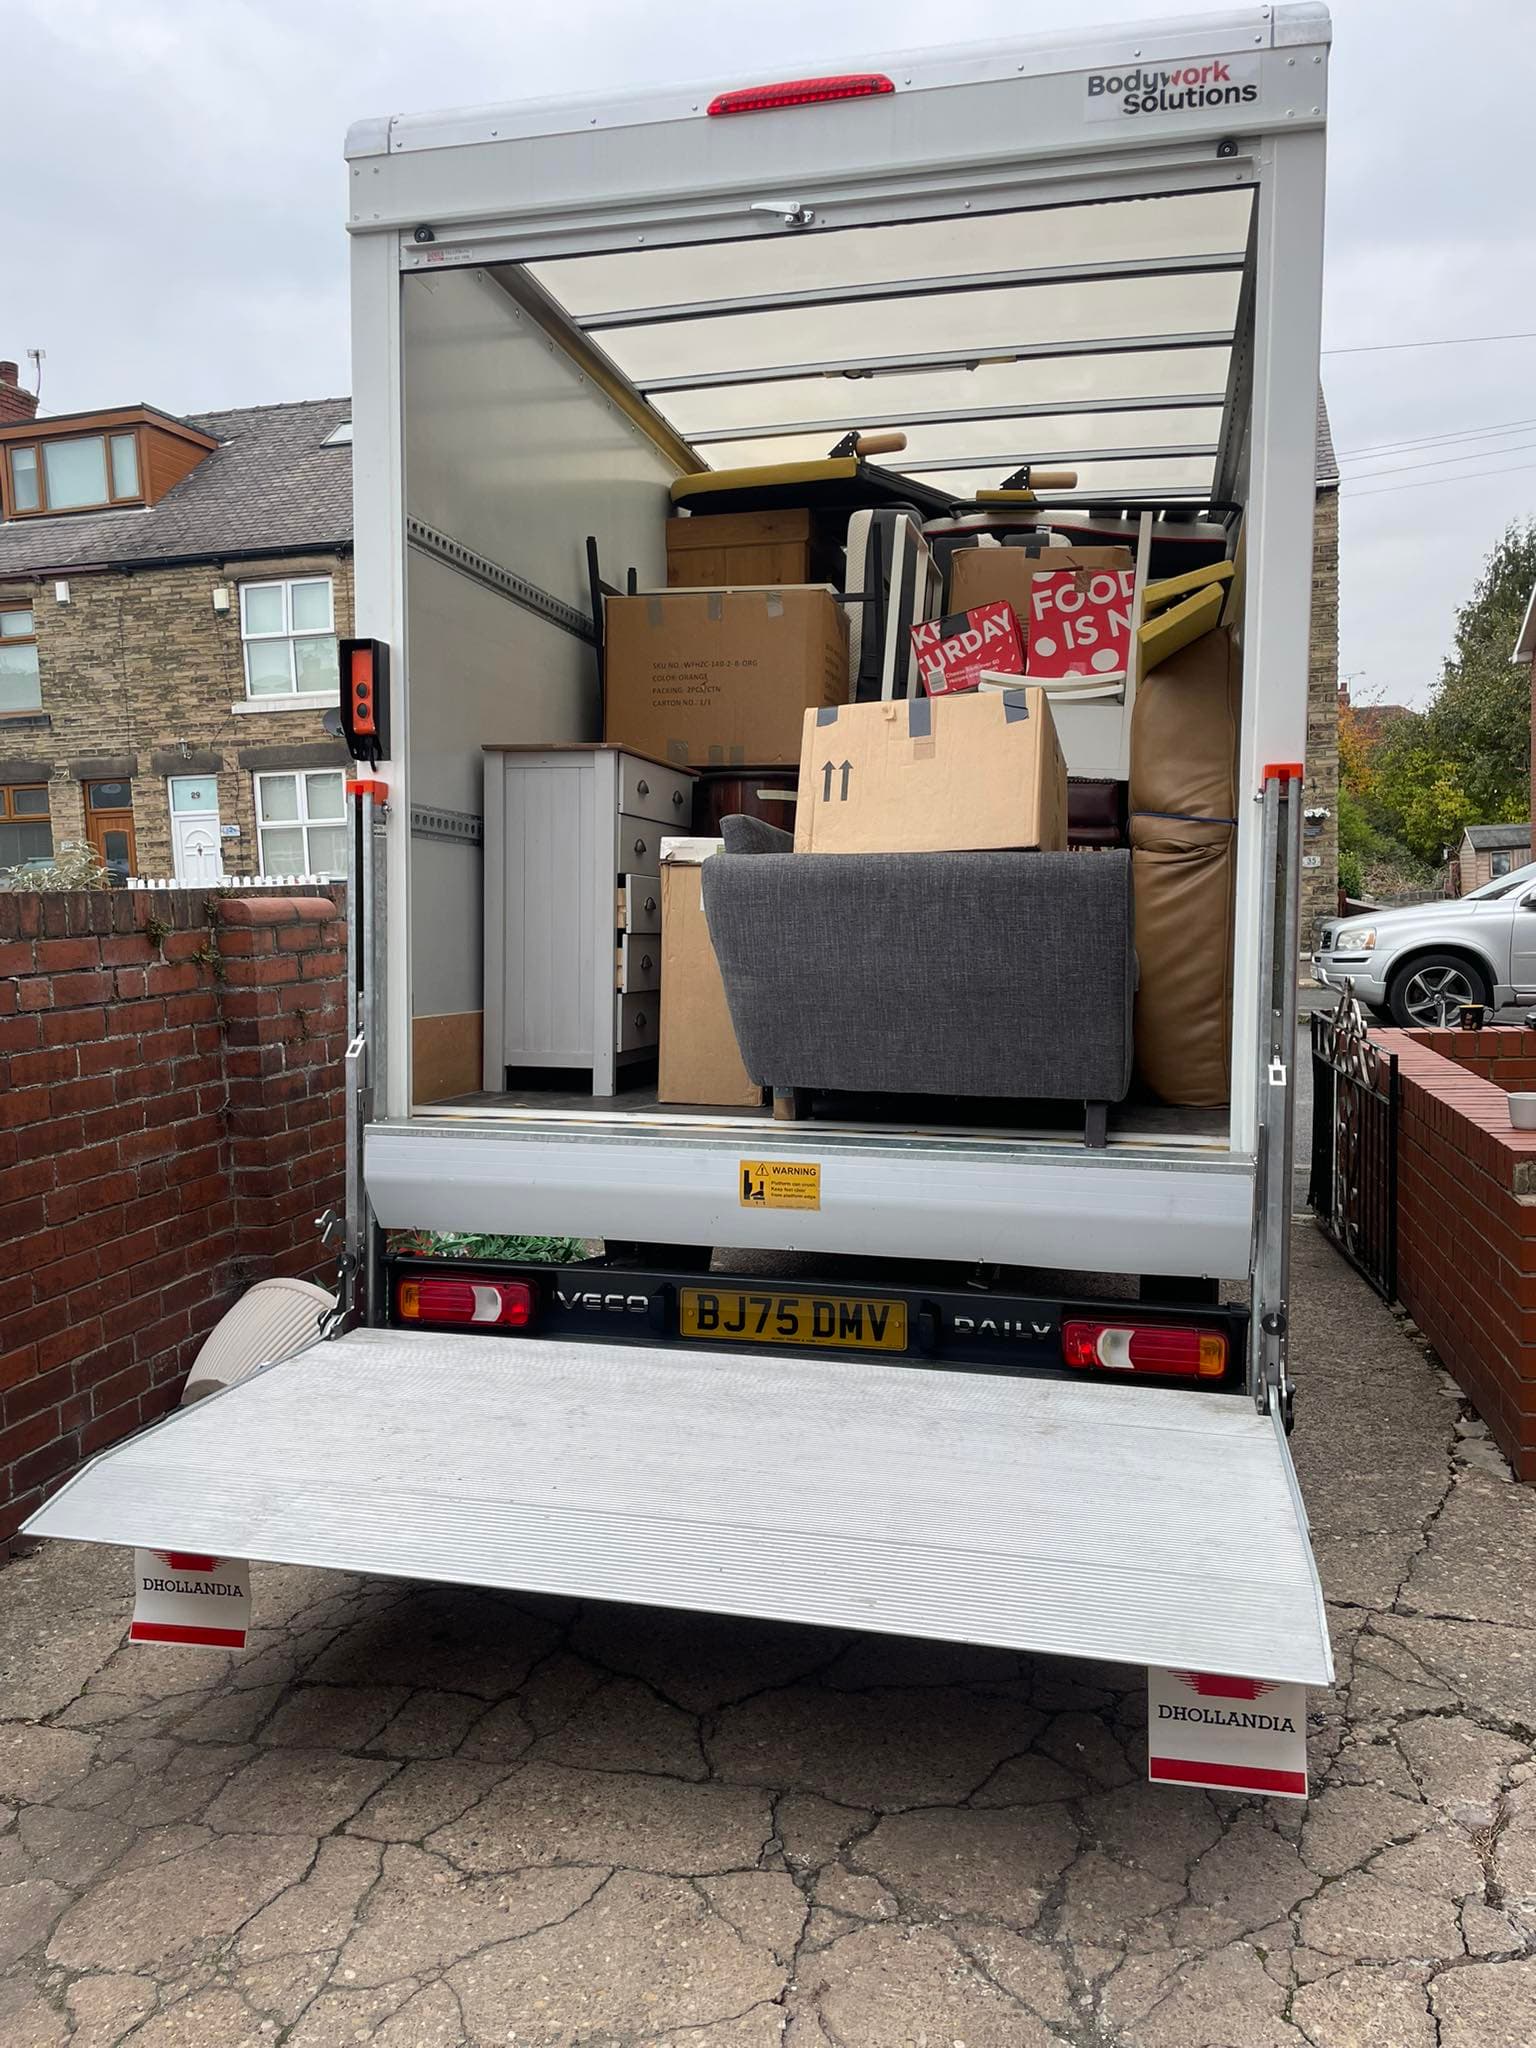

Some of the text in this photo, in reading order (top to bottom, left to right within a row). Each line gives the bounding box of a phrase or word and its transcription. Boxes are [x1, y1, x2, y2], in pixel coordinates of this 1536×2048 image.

[1088, 60, 1231, 97] Bodywork
[1123, 84, 1258, 115] Solutions
[1062, 615, 1099, 650] IS
[190, 791, 201, 800] 29
[772, 1166, 817, 1177] WARNING
[697, 1294, 890, 1342] BJ75 DMV
[954, 1316, 1052, 1340] DAILY
[143, 1578, 244, 1597] DHOLLANDIA
[1158, 1704, 1297, 1733] DHOLLANDIA
